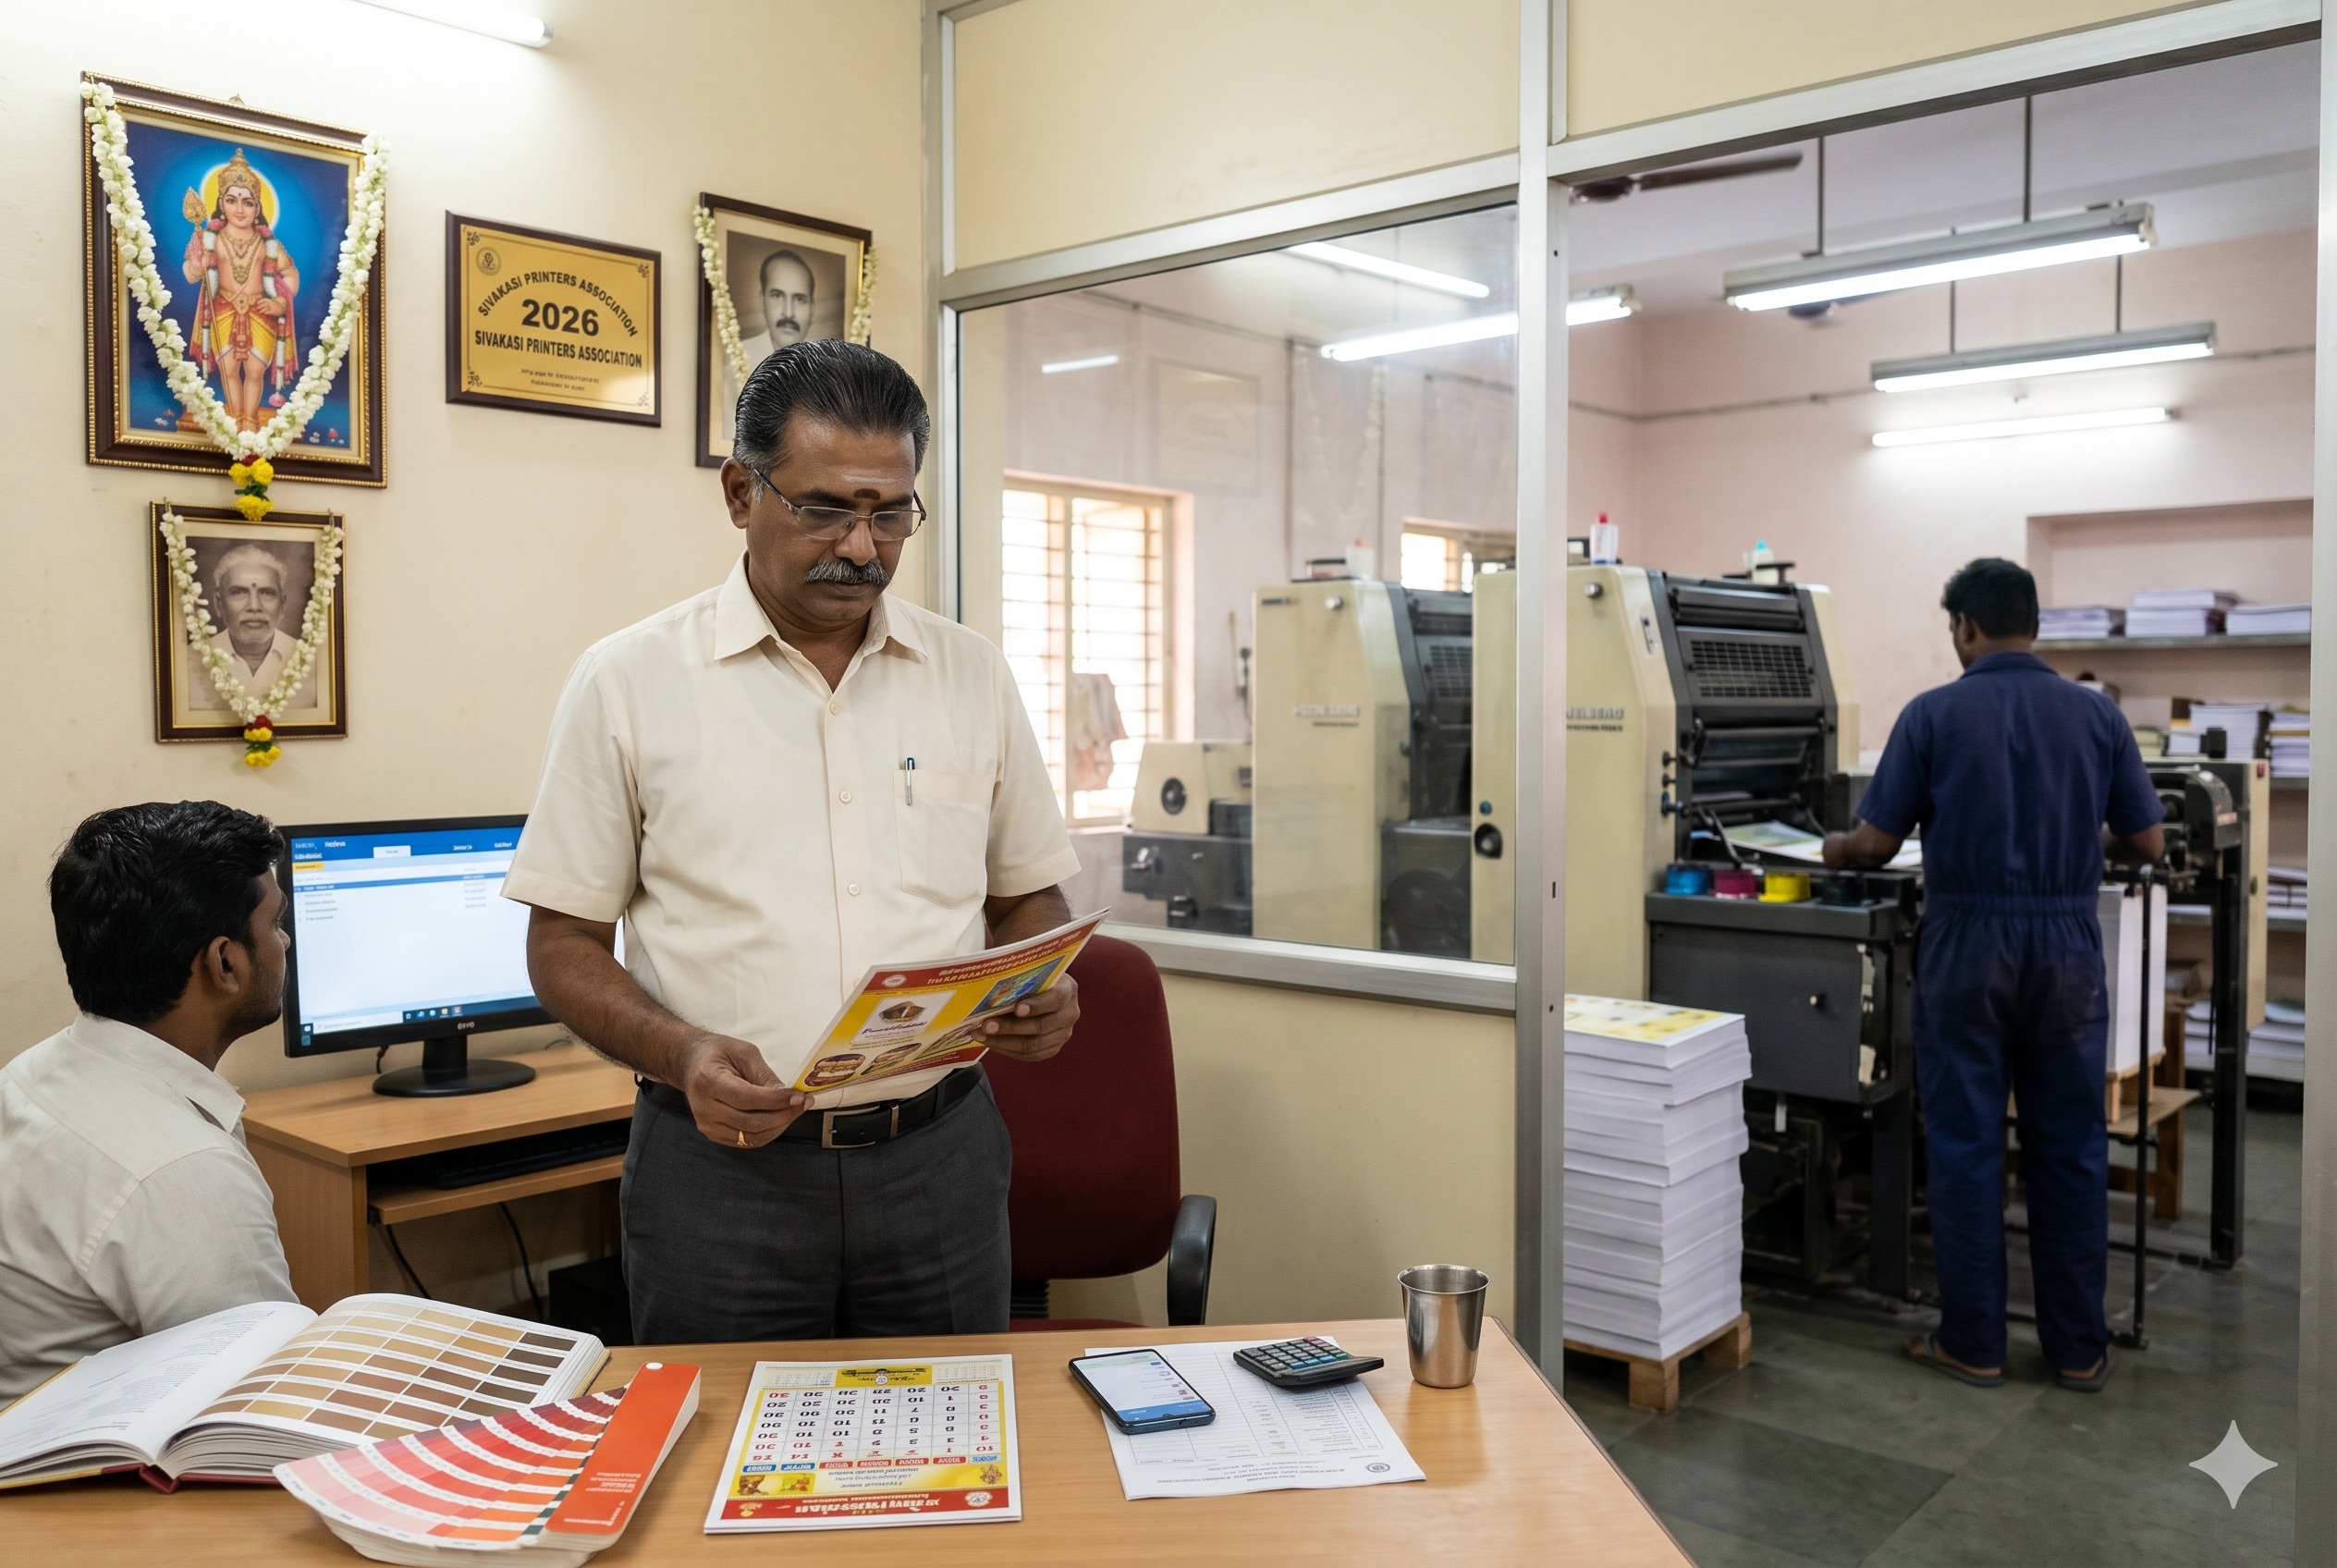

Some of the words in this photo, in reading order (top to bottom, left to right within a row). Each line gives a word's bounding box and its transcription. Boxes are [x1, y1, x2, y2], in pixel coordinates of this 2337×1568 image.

[478, 276, 522, 316] SIVAKASI
[524, 271, 577, 287] PRINTERS
[580, 278, 638, 337] ASSOCIATION
[521, 299, 599, 337] 2026
[475, 330, 523, 350] SIVAKASI
[526, 337, 576, 359] PRINTERS
[578, 345, 642, 368] ASSOCIATION
